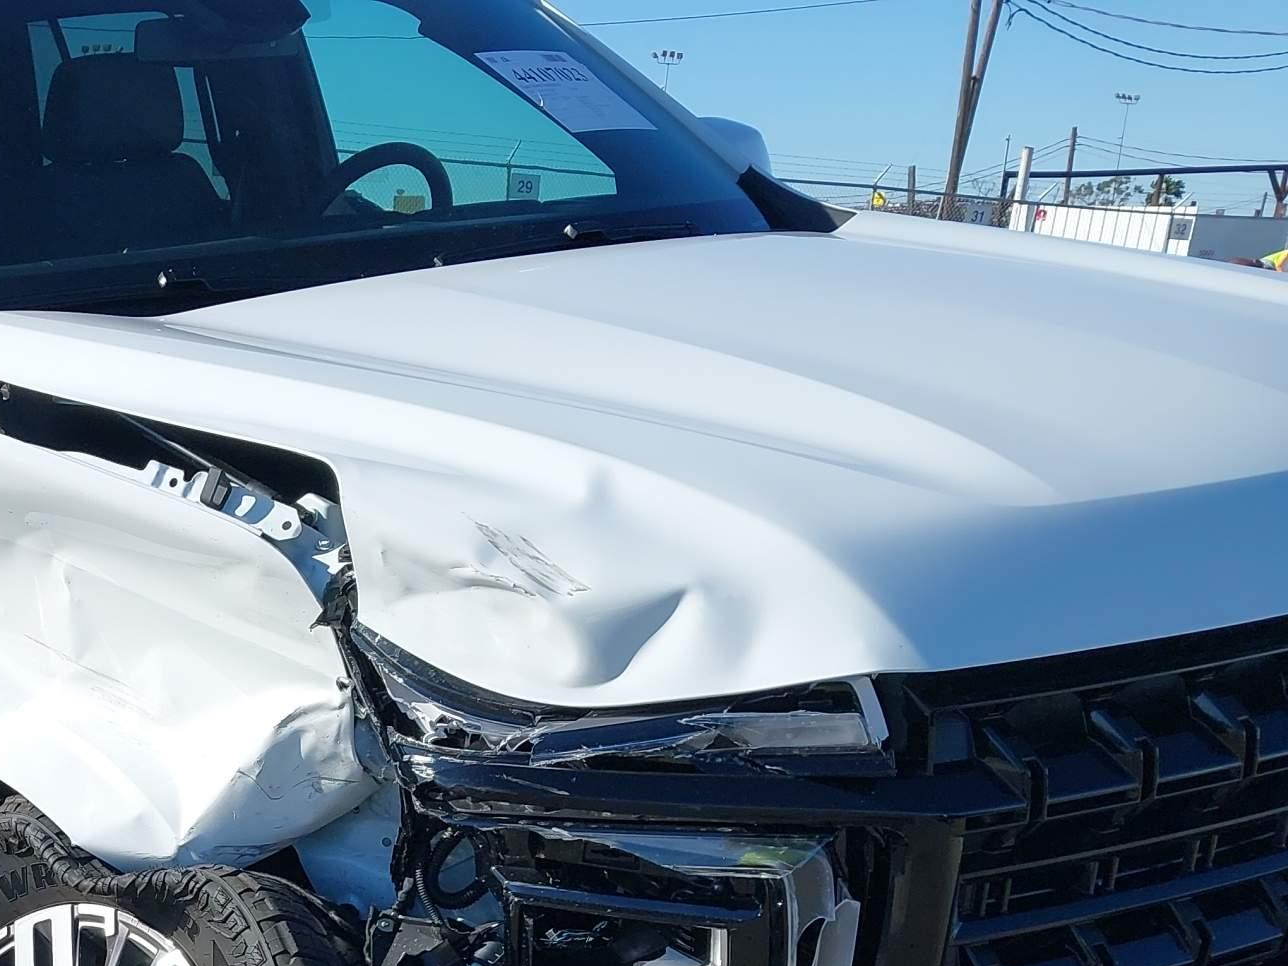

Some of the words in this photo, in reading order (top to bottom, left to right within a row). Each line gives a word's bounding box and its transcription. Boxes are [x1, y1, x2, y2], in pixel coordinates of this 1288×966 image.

[512, 66, 589, 83] 44107023
[517, 180, 533, 194] 29
[971, 210, 985, 223] 31
[1174, 223, 1187, 235] 32
